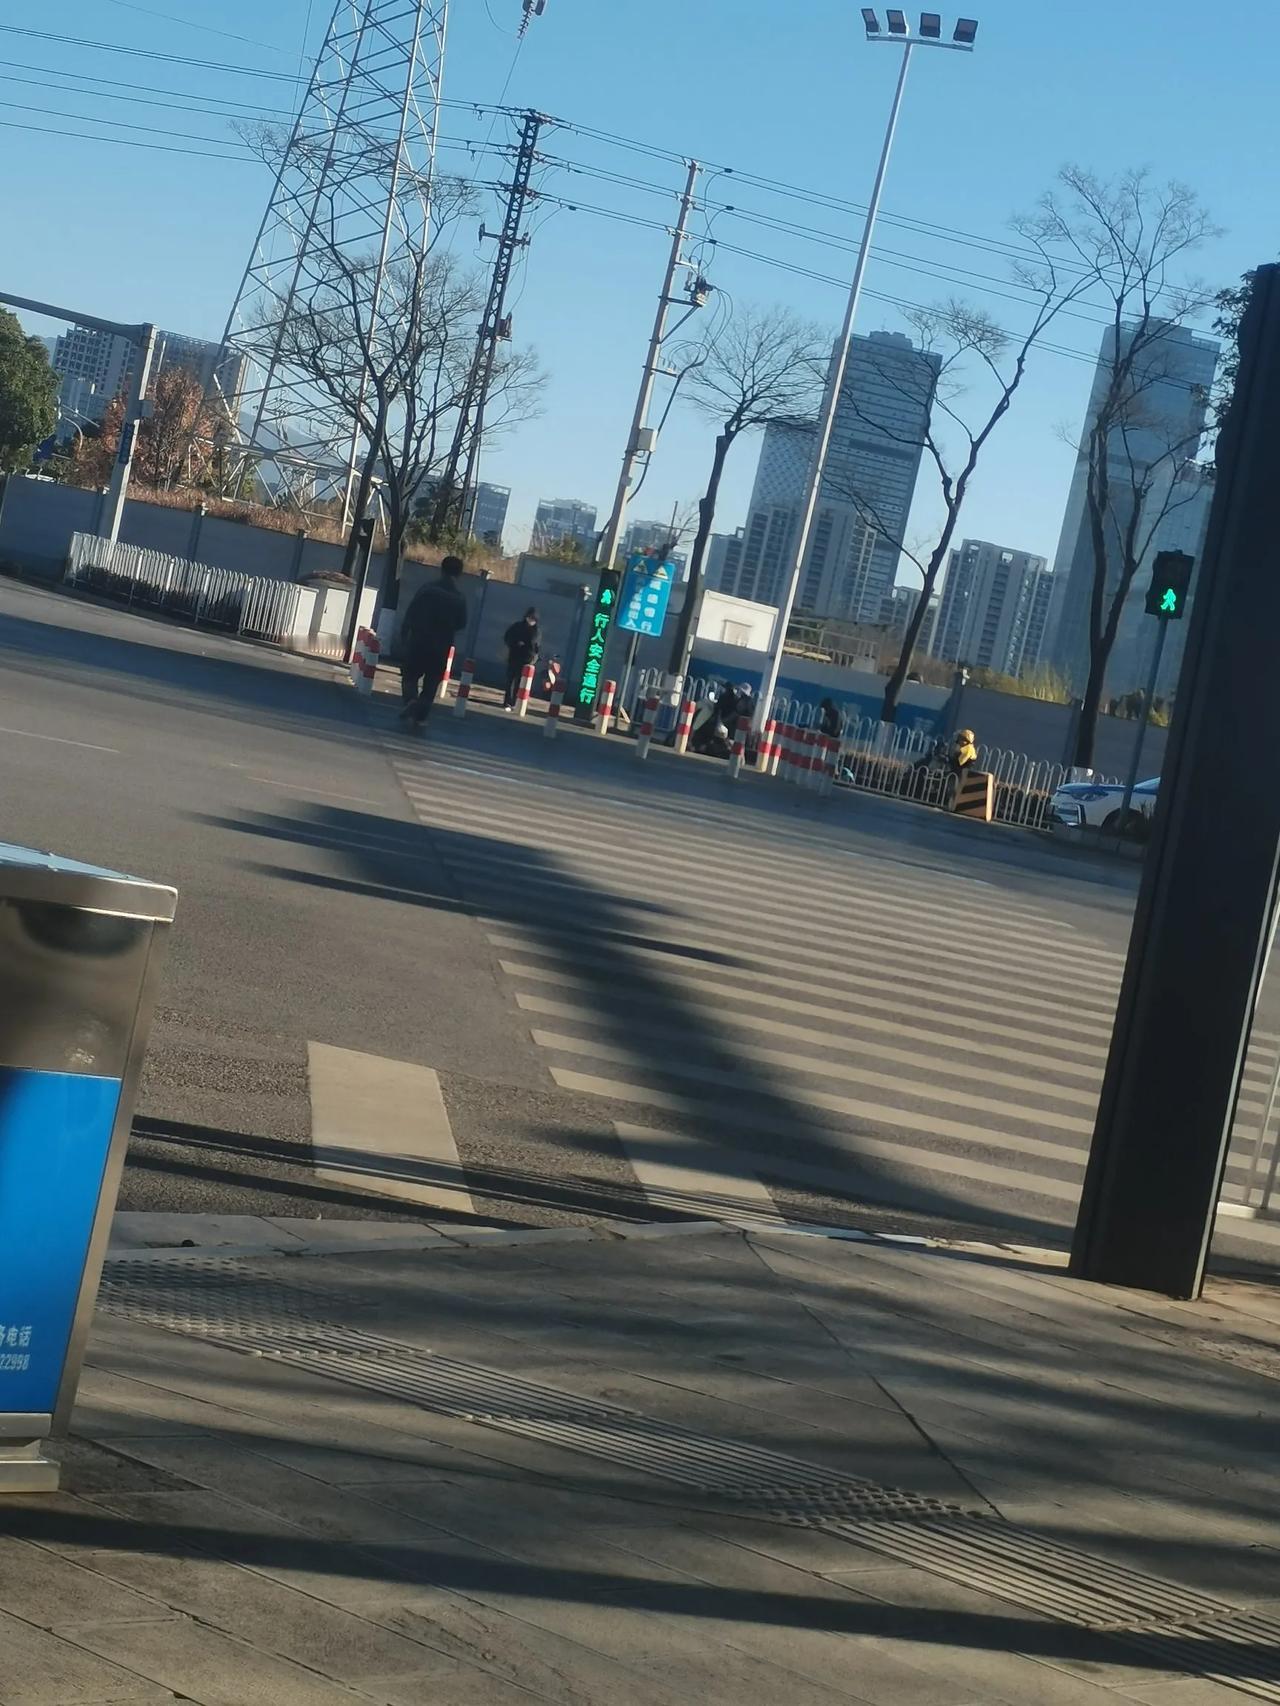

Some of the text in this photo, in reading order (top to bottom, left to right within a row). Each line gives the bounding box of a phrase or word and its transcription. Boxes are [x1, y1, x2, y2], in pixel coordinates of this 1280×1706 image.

[580, 612, 610, 704] 行人安全通行
